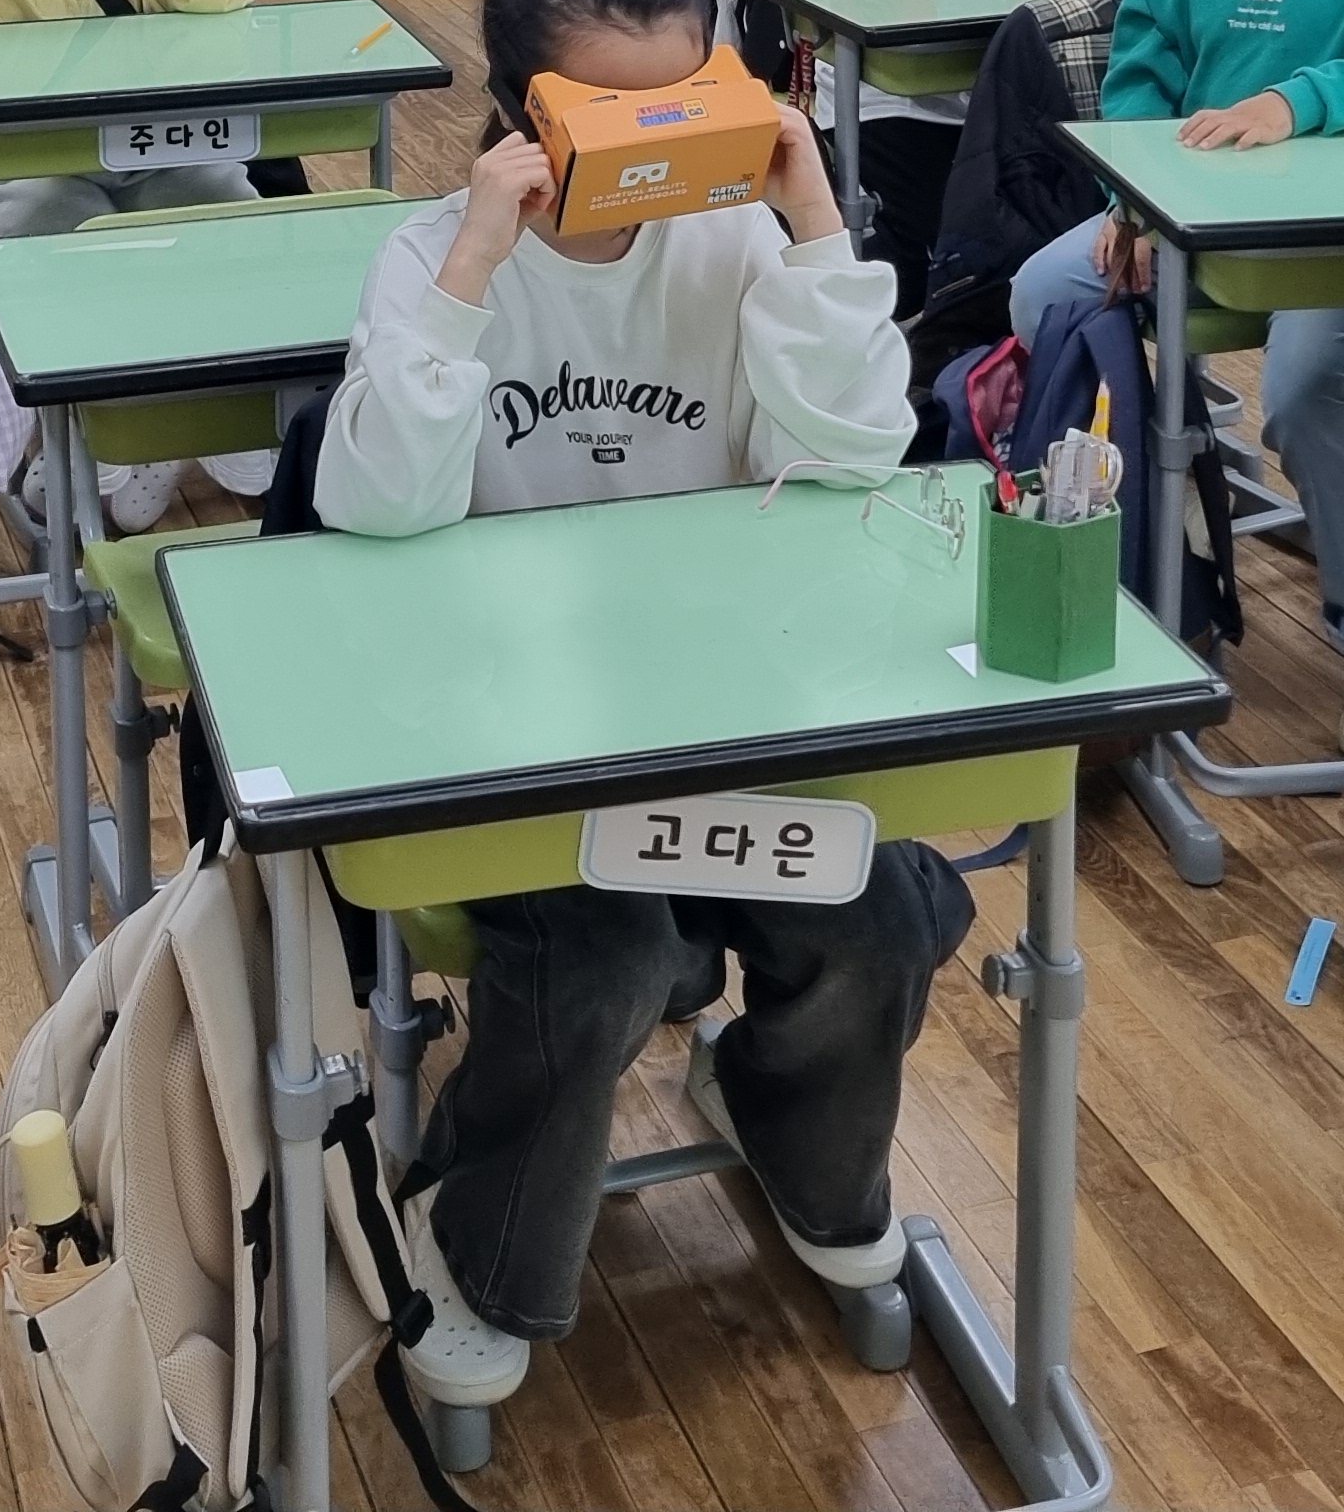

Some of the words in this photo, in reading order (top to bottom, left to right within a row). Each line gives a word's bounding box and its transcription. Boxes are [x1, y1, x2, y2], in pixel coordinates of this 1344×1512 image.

[129, 118, 230, 156] 주다인
[740, 172, 755, 182] 3D
[591, 194, 604, 203] 3D
[606, 188, 643, 201] VIRTUAL
[644, 181, 687, 194] REALITY
[706, 190, 750, 205] REALITY
[708, 182, 752, 196] VIRTUAL
[589, 197, 629, 211] GOOGLE
[630, 187, 688, 204] CARDBOARD
[489, 360, 706, 450] Delaware
[565, 431, 594, 445] YOUR
[597, 450, 621, 462] TIME
[637, 813, 815, 879] 고다은
